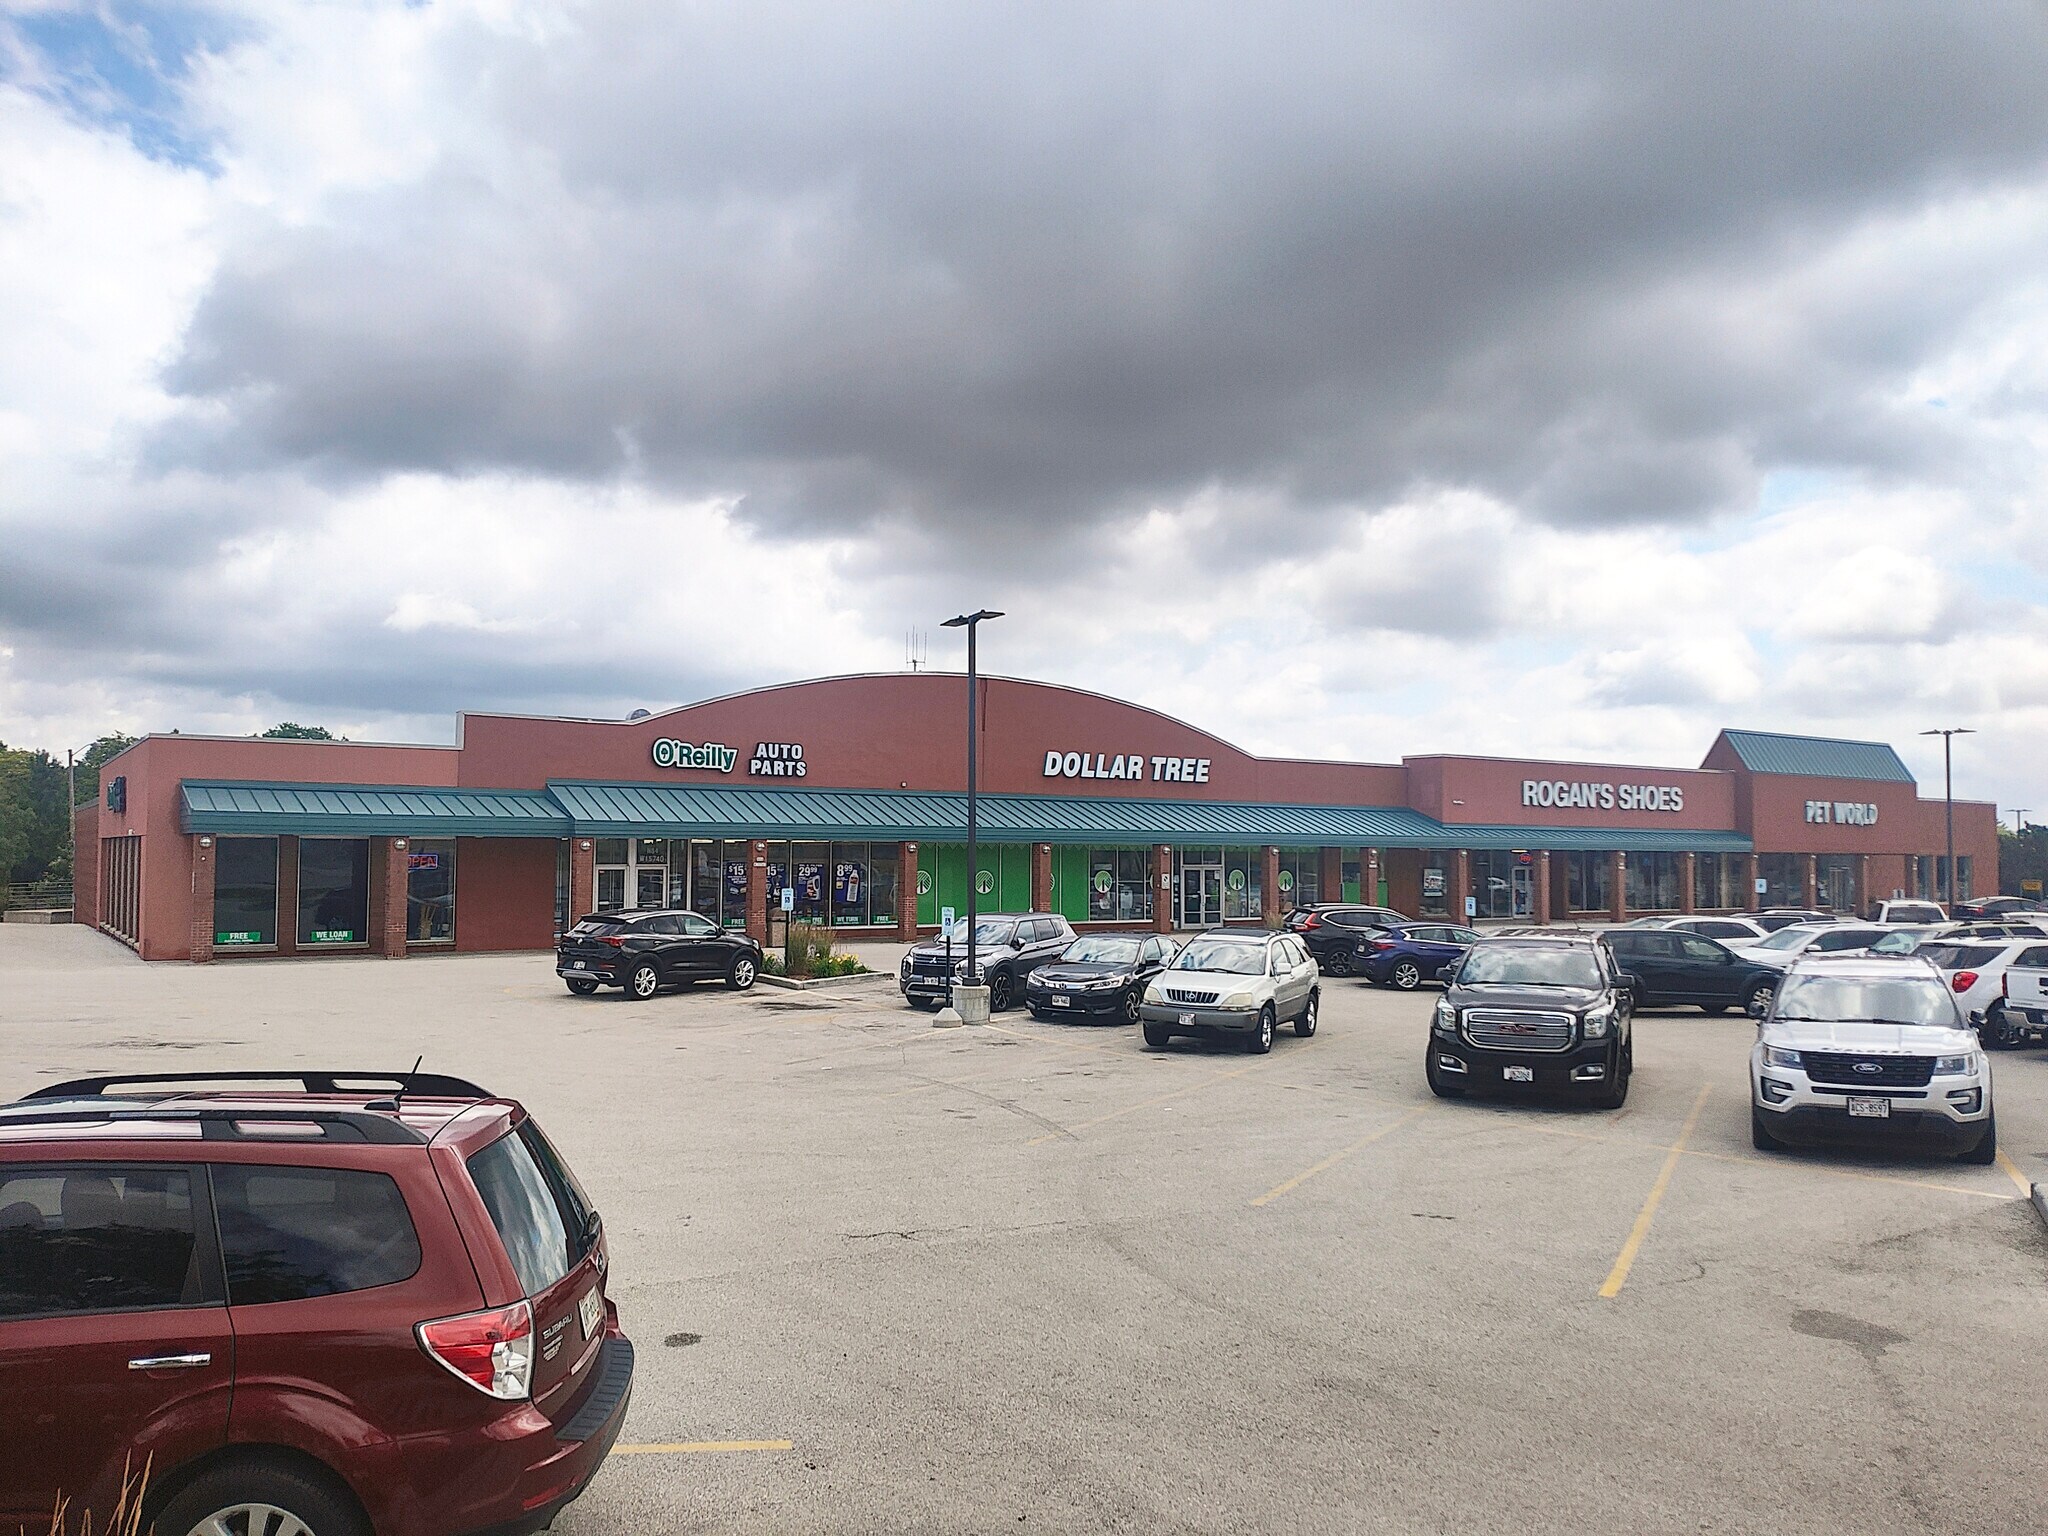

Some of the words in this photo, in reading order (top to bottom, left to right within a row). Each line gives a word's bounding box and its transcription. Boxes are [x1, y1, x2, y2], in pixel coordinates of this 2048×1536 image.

[654, 738, 737, 772] O'Reilly
[756, 743, 803, 760] AUTO
[750, 760, 807, 777] PARTS
[1044, 751, 1144, 780] DOLLAR
[1151, 756, 1211, 783] TREE
[1522, 780, 1614, 809] ROGAN'S
[1618, 784, 1684, 812] SHOES
[1805, 800, 1831, 823] PET
[1833, 802, 1878, 827] WORLD
[729, 865, 744, 876] $15
[229, 932, 249, 940] FREE
[316, 931, 328, 939] WE
[542, 1313, 573, 1340] SUBARU
